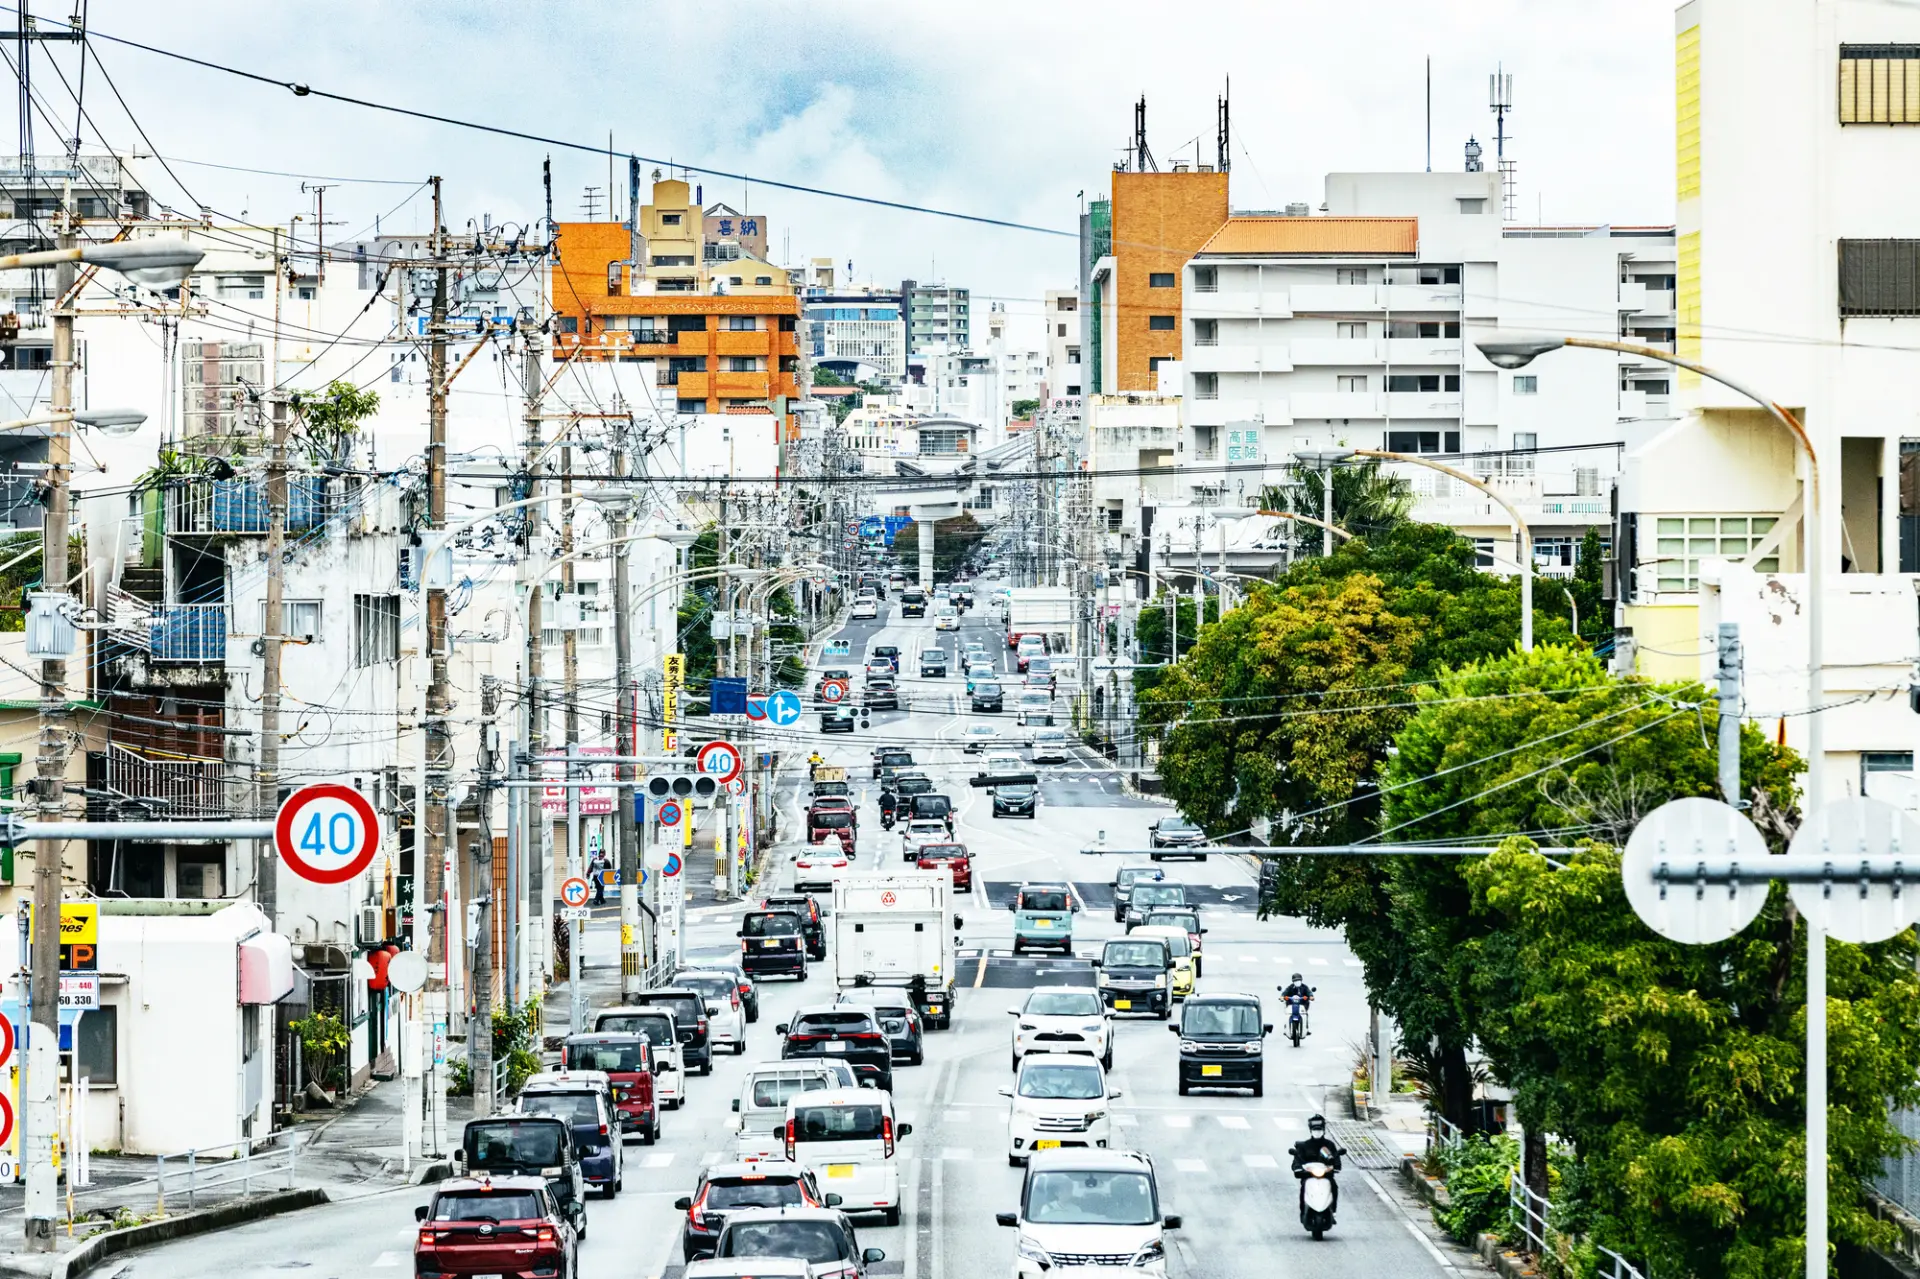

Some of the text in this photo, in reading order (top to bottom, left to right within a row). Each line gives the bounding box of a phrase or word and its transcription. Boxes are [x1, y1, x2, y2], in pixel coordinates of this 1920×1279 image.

[718, 219, 758, 236] 喜納
[1229, 430, 1257, 444] 高里
[1229, 446, 1257, 460] 医院
[707, 753, 731, 773] 40
[300, 811, 357, 857] 40
[72, 944, 94, 969] P
[74, 995, 92, 1005] 330
